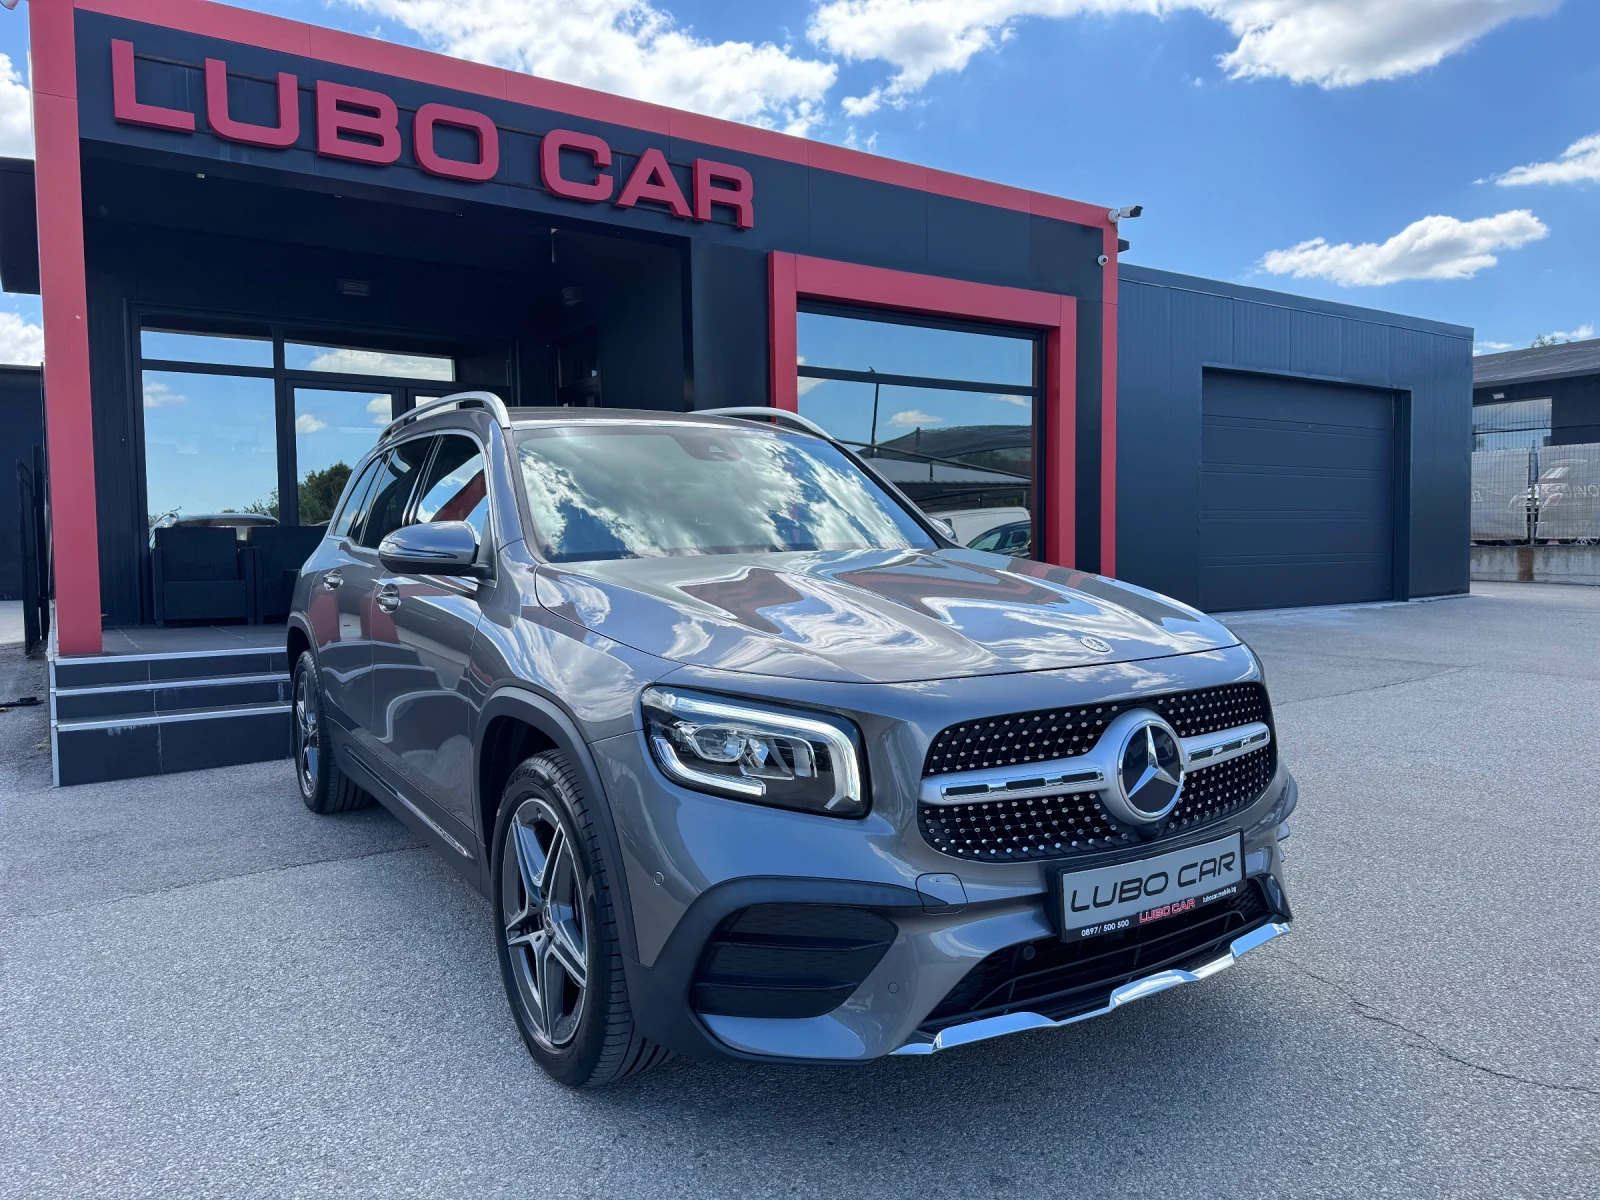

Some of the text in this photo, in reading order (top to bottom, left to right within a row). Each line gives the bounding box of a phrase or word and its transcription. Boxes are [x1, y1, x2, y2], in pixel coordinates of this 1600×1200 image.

[111, 38, 754, 229] LUBO CAR
[1070, 851, 1236, 913] LUBO CAR
[1081, 919, 1130, 937] 0897/ 500 500
[1138, 898, 1196, 923] LUBO CAR
